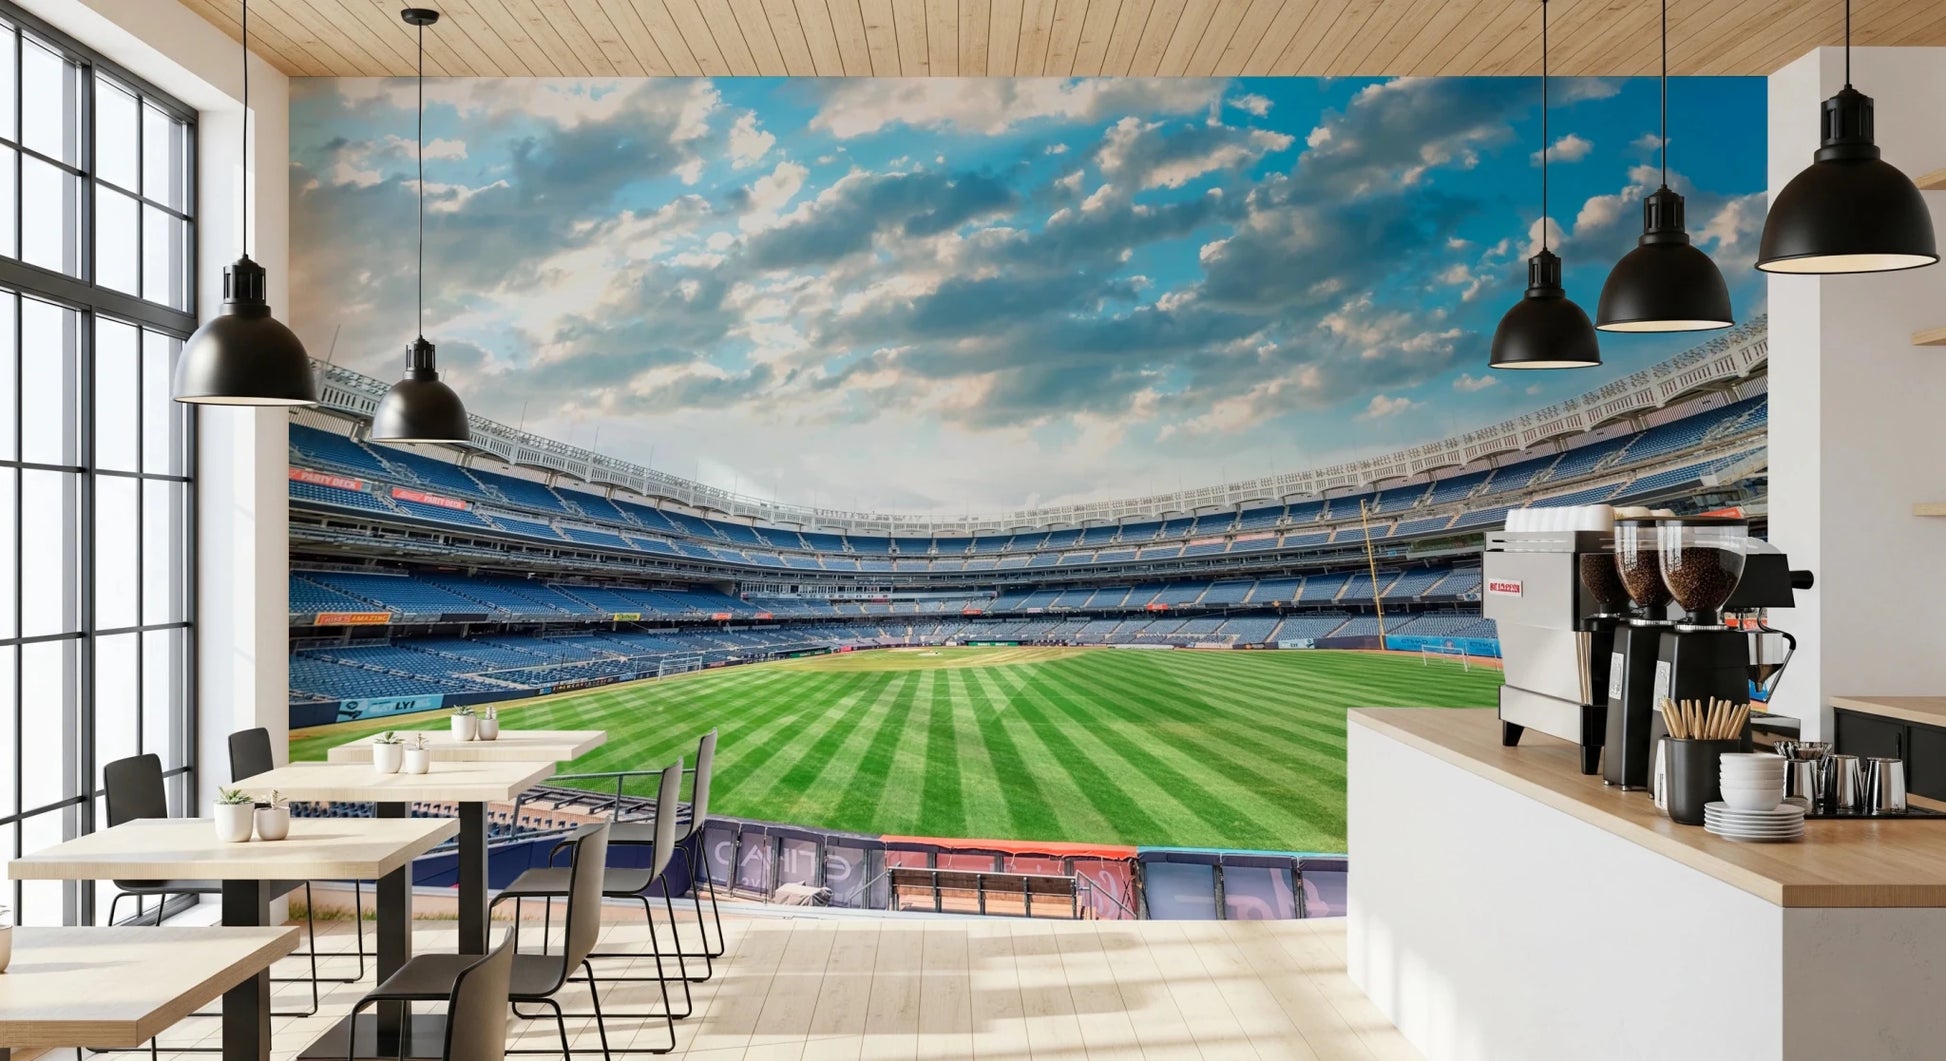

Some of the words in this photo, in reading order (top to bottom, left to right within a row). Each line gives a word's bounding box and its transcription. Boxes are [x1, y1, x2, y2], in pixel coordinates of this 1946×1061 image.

[302, 471, 334, 486] PARTY
[333, 479, 357, 491] DECK
[424, 495, 446, 506] PARTY
[445, 500, 463, 510] DECK
